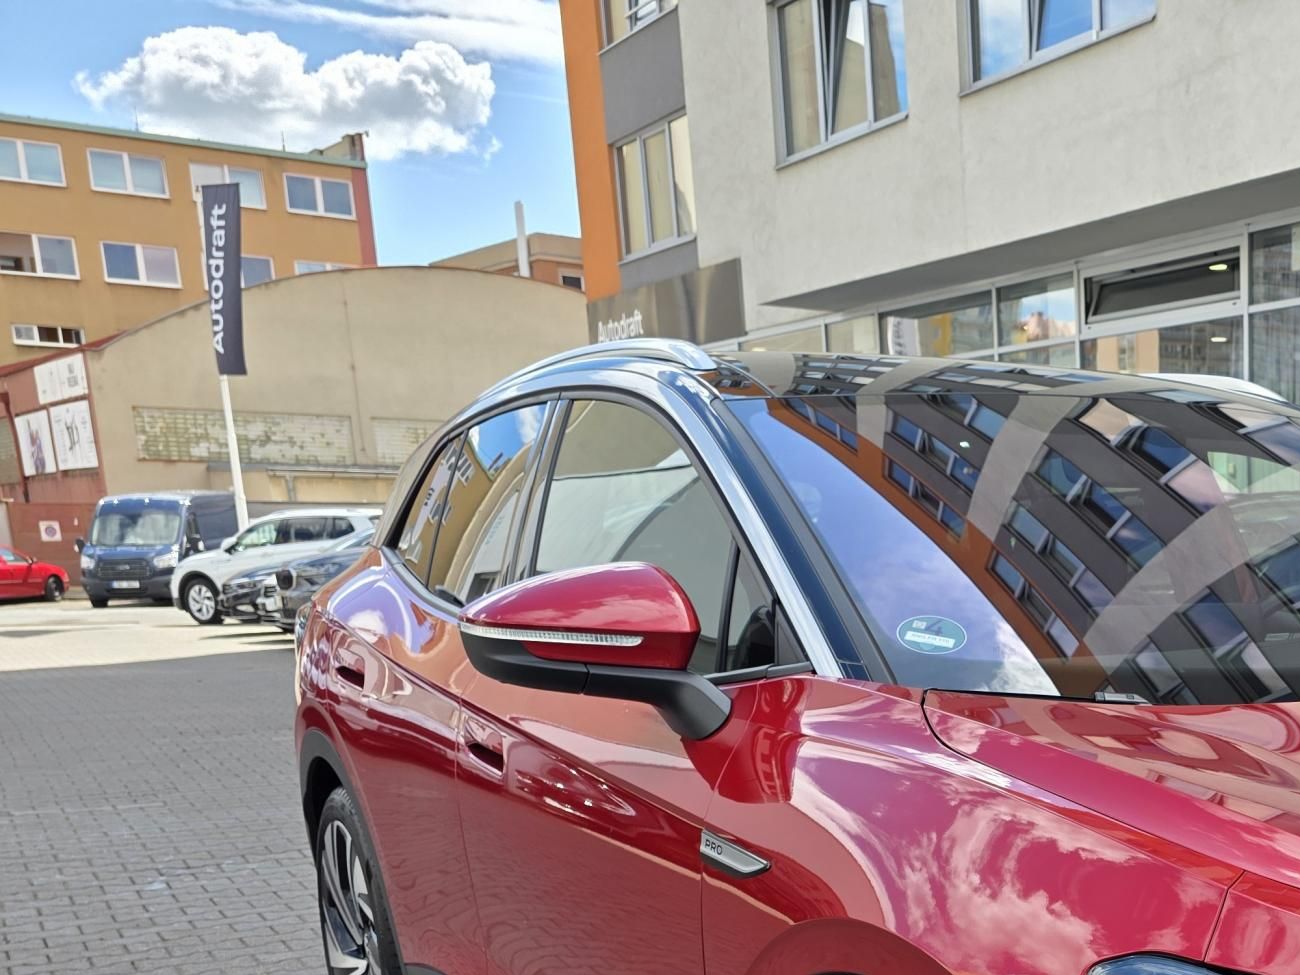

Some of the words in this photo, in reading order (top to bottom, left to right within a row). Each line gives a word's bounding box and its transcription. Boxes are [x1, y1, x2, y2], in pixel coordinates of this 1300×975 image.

[208, 203, 226, 354] Autodraft
[598, 309, 644, 343] Autodraft
[705, 839, 723, 856] PRO
